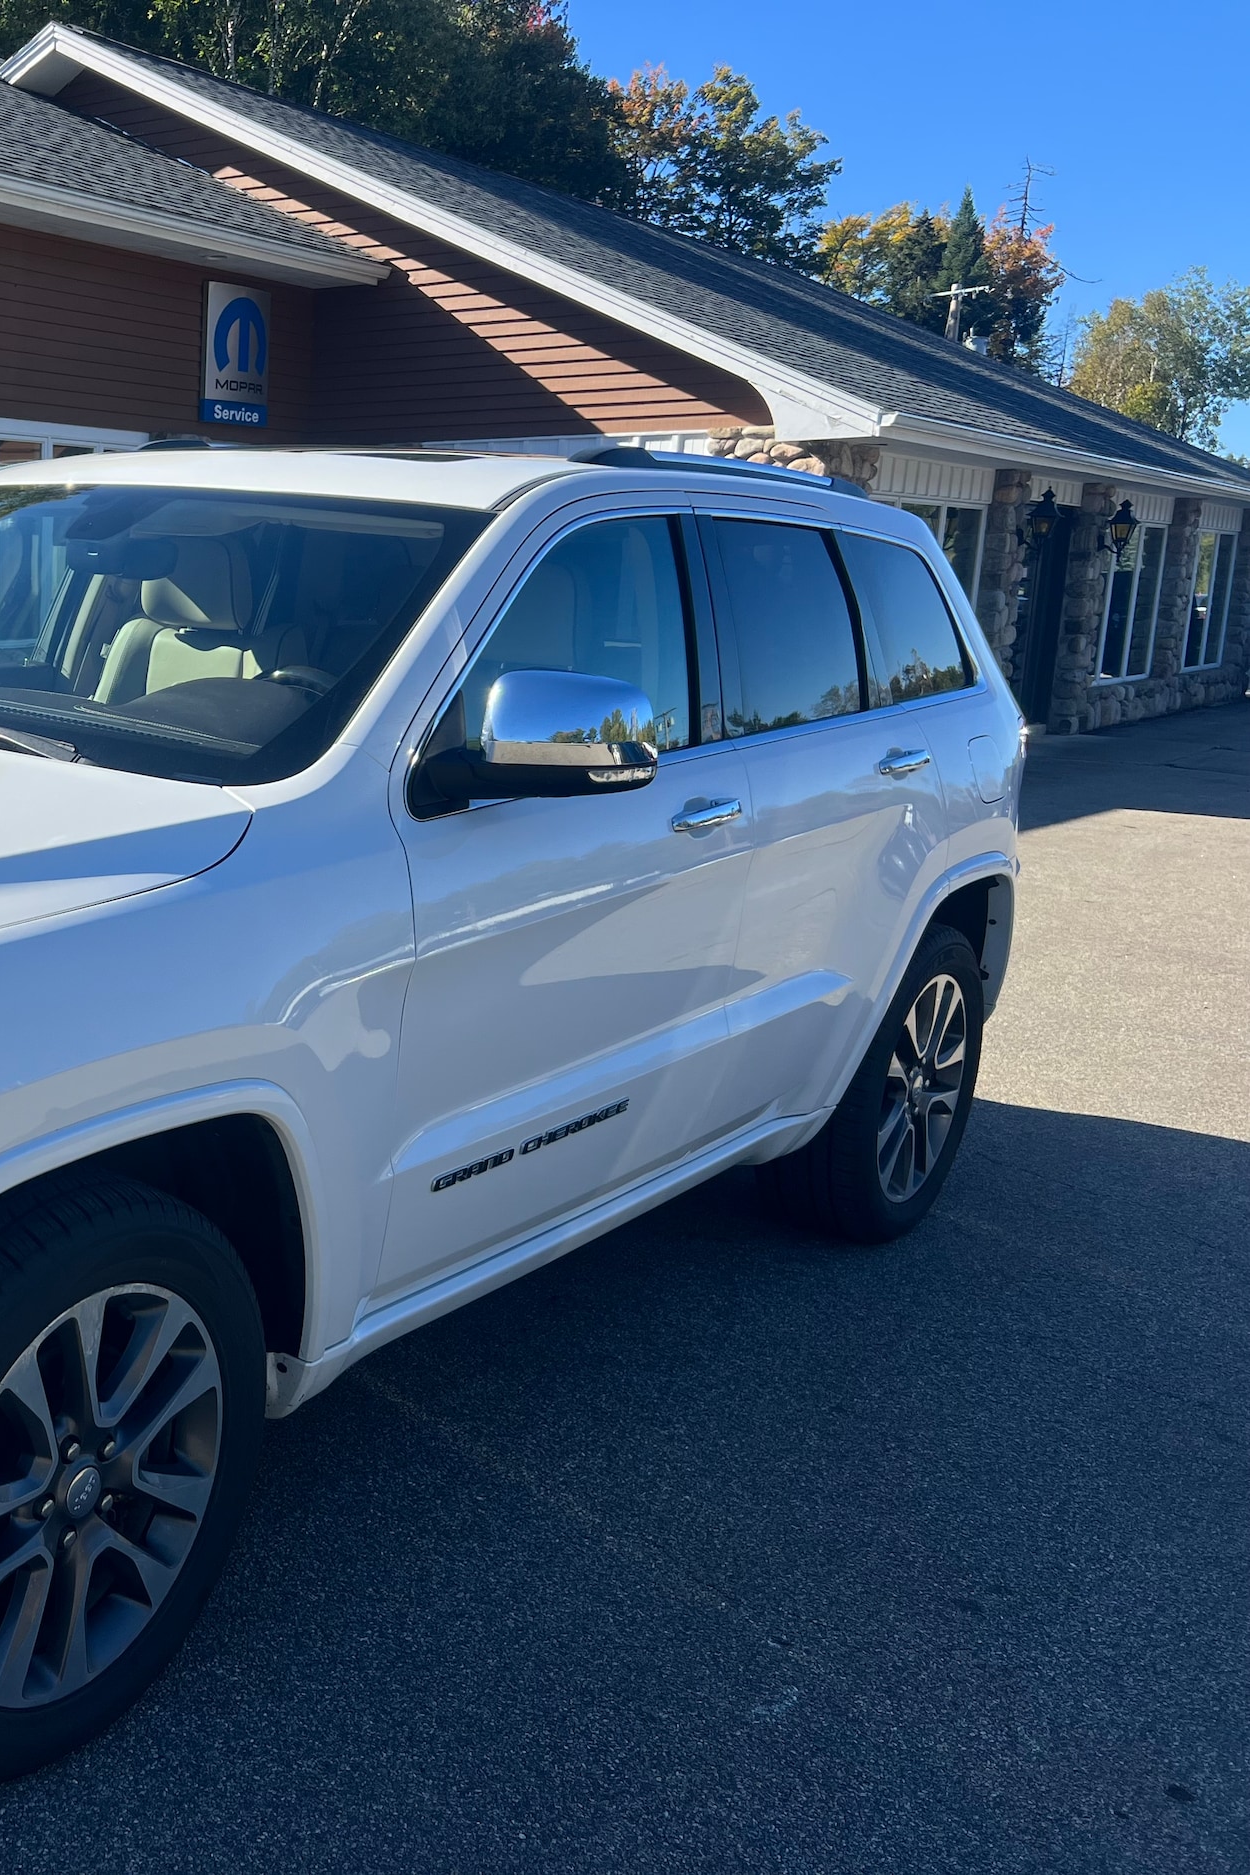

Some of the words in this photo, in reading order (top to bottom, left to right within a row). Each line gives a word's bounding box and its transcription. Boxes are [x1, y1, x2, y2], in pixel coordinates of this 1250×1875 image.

[215, 378, 263, 395] MOPAR
[213, 404, 259, 423] Service
[430, 1146, 515, 1192] GRAND
[519, 1096, 630, 1155] CHEROKEE
